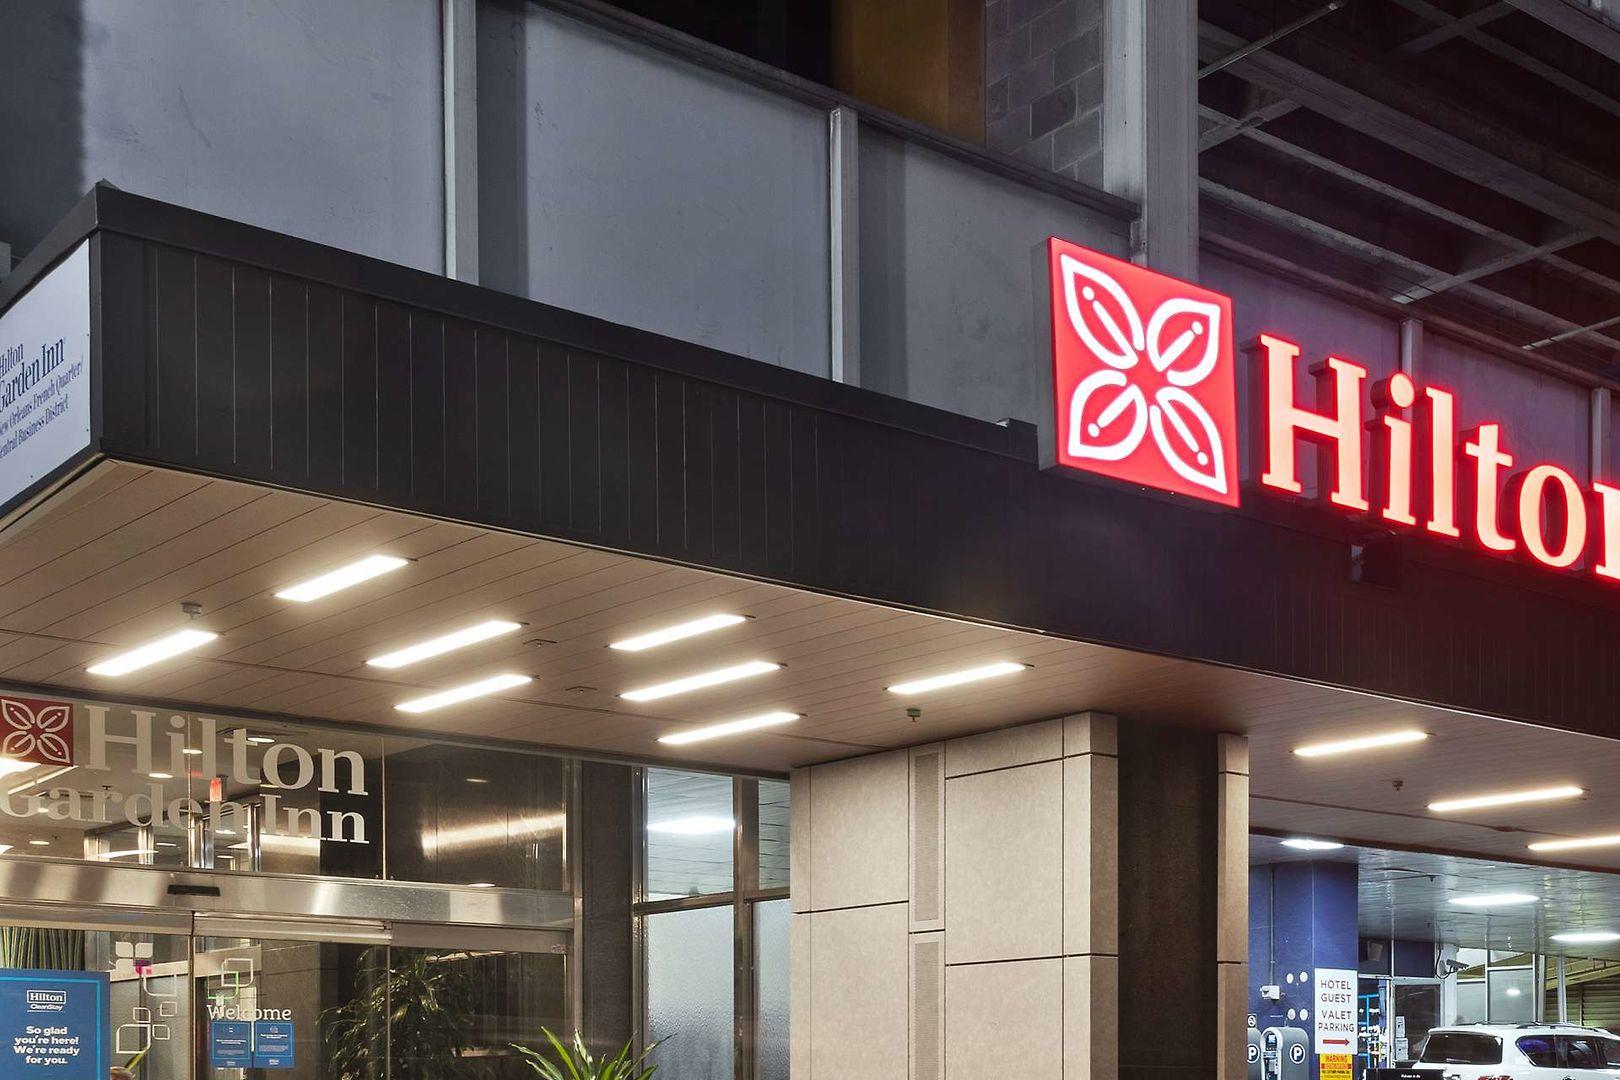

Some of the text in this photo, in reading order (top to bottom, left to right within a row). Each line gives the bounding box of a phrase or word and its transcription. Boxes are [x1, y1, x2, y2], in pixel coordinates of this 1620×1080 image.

[41, 338, 65, 379] Inn
[9, 400, 33, 426] Orleans
[33, 378, 56, 411] French
[0, 392, 69, 460] entral Business District
[83, 703, 370, 797] Hilton
[0, 773, 370, 845] Garden Inn
[1320, 979, 1352, 990] HOTEL
[30, 992, 63, 1002] Hilton
[1320, 993, 1352, 1003] GUEST
[206, 1004, 292, 1020] Welcome
[1321, 1010, 1352, 1020] VALET
[26, 1025, 68, 1036] So glad
[1318, 1022, 1355, 1033] PARKING
[14, 1035, 79, 1046] you're here!
[13, 1045, 80, 1056] We're ready
[1293, 1046, 1302, 1061] P
[25, 1055, 68, 1066] for you.
